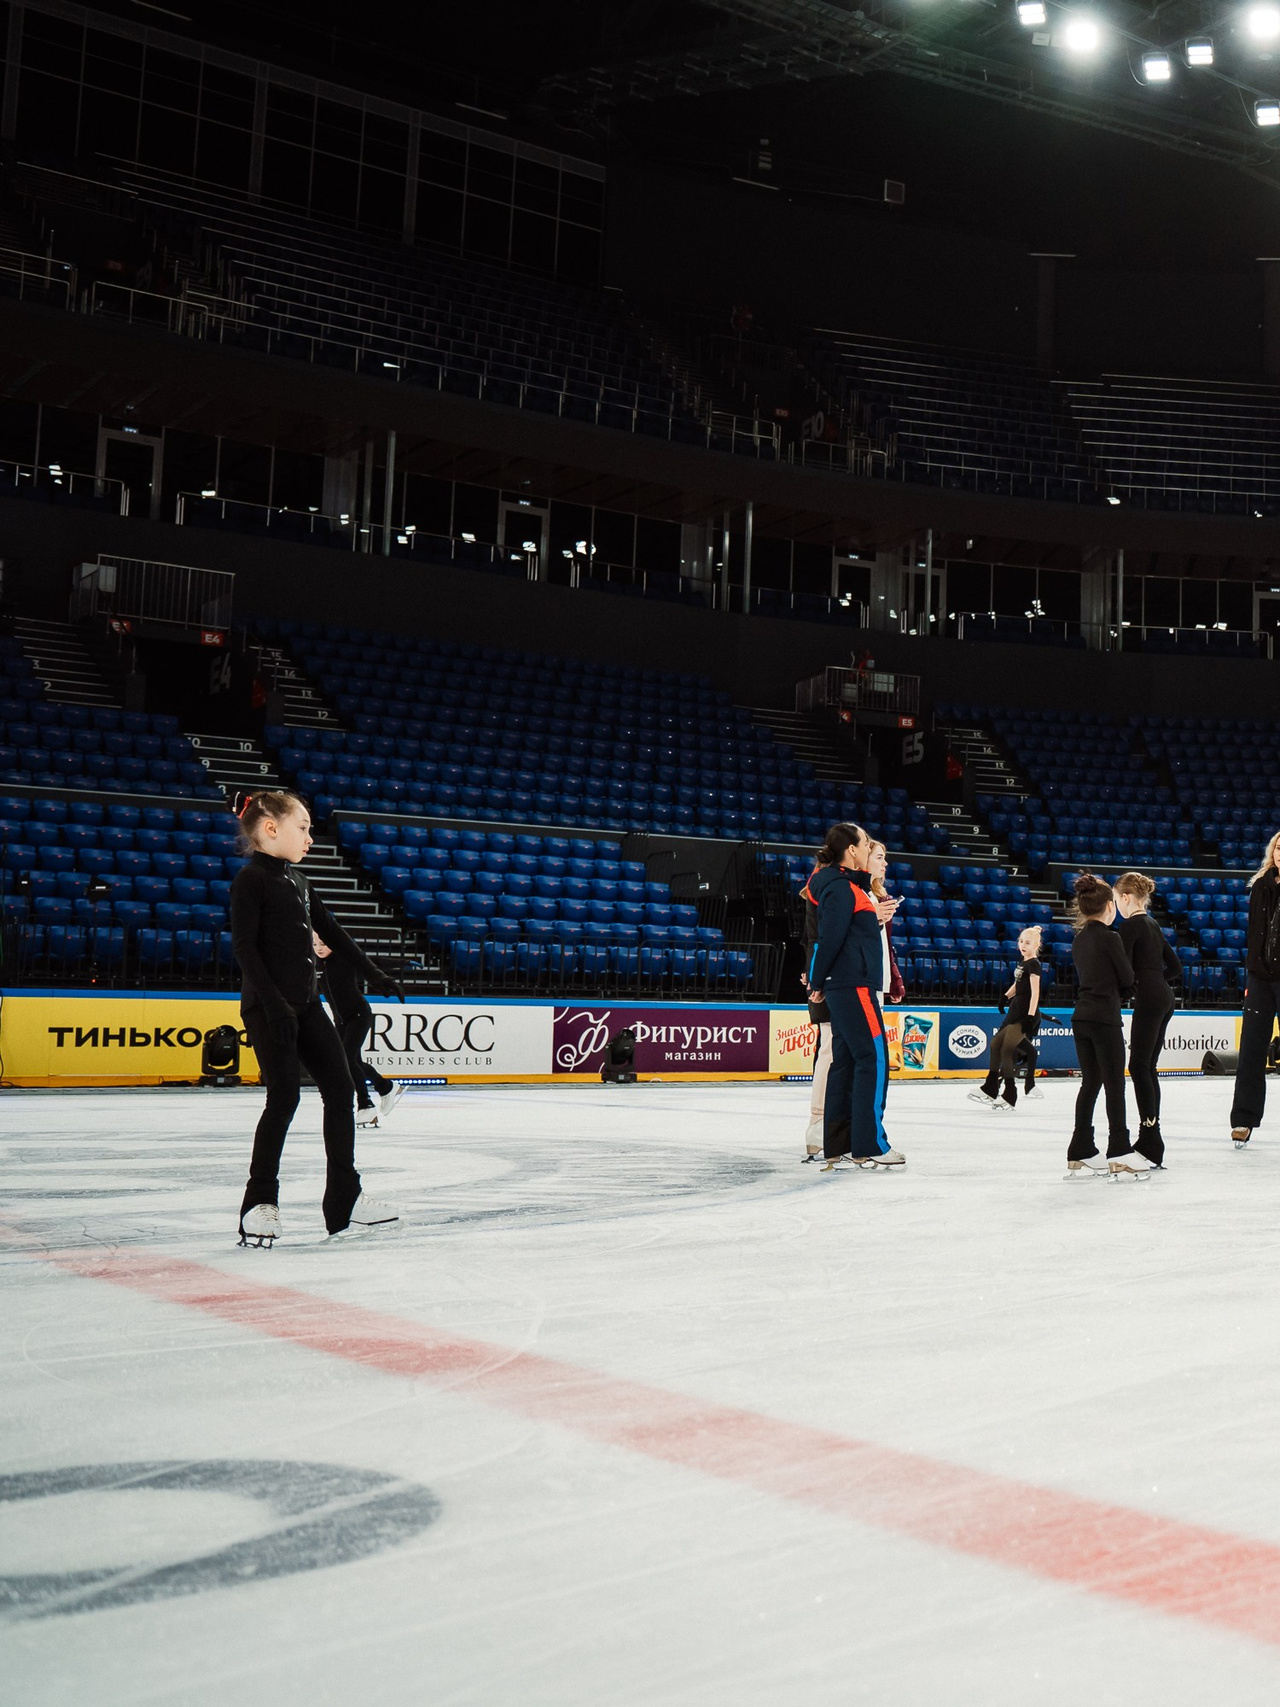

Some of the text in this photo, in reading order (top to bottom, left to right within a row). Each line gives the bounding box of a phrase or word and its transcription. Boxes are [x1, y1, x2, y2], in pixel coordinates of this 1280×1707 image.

[205, 634, 220, 644] E4
[902, 718, 913, 726] E5
[239, 742, 252, 752] 10
[902, 731, 924, 765] E5
[260, 765, 268, 774] 9
[992, 847, 998, 855] 8
[1012, 868, 1018, 876] 7
[364, 1013, 495, 1052] RRCC
[628, 1021, 757, 1049] Фигурист
[665, 1052, 721, 1061] магазин
[366, 1057, 493, 1066] BUSINESS CLUB
